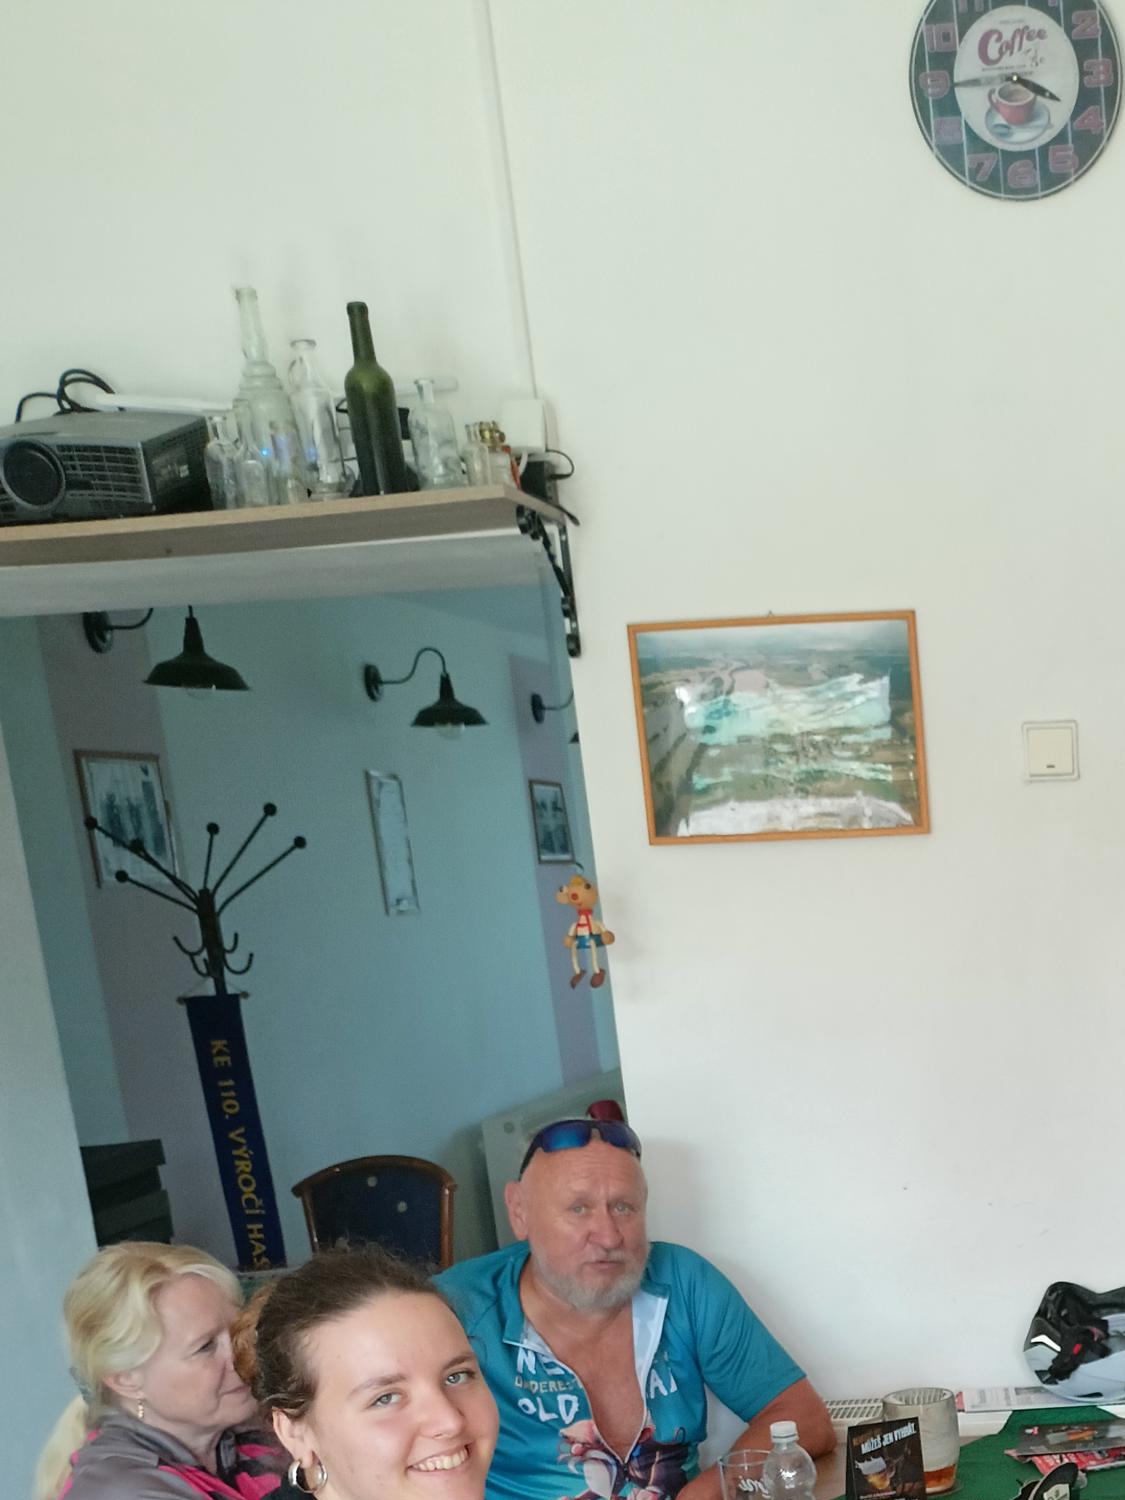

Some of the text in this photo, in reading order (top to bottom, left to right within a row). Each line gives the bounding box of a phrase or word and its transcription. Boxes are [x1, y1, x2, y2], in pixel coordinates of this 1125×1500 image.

[924, 22, 957, 52] 10
[1072, 10, 1102, 40] 2
[978, 25, 1048, 66] Coffee
[1083, 58, 1114, 88] 3
[1074, 105, 1105, 134] 4
[968, 153, 998, 182] 7
[1048, 145, 1079, 173] 5
[1007, 160, 1038, 189] 6
[210, 1039, 232, 1068] KE
[218, 1079, 241, 1119] 110.
[228, 1126, 266, 1215] VÝROČÍ
[517, 1393, 580, 1424] OLD
